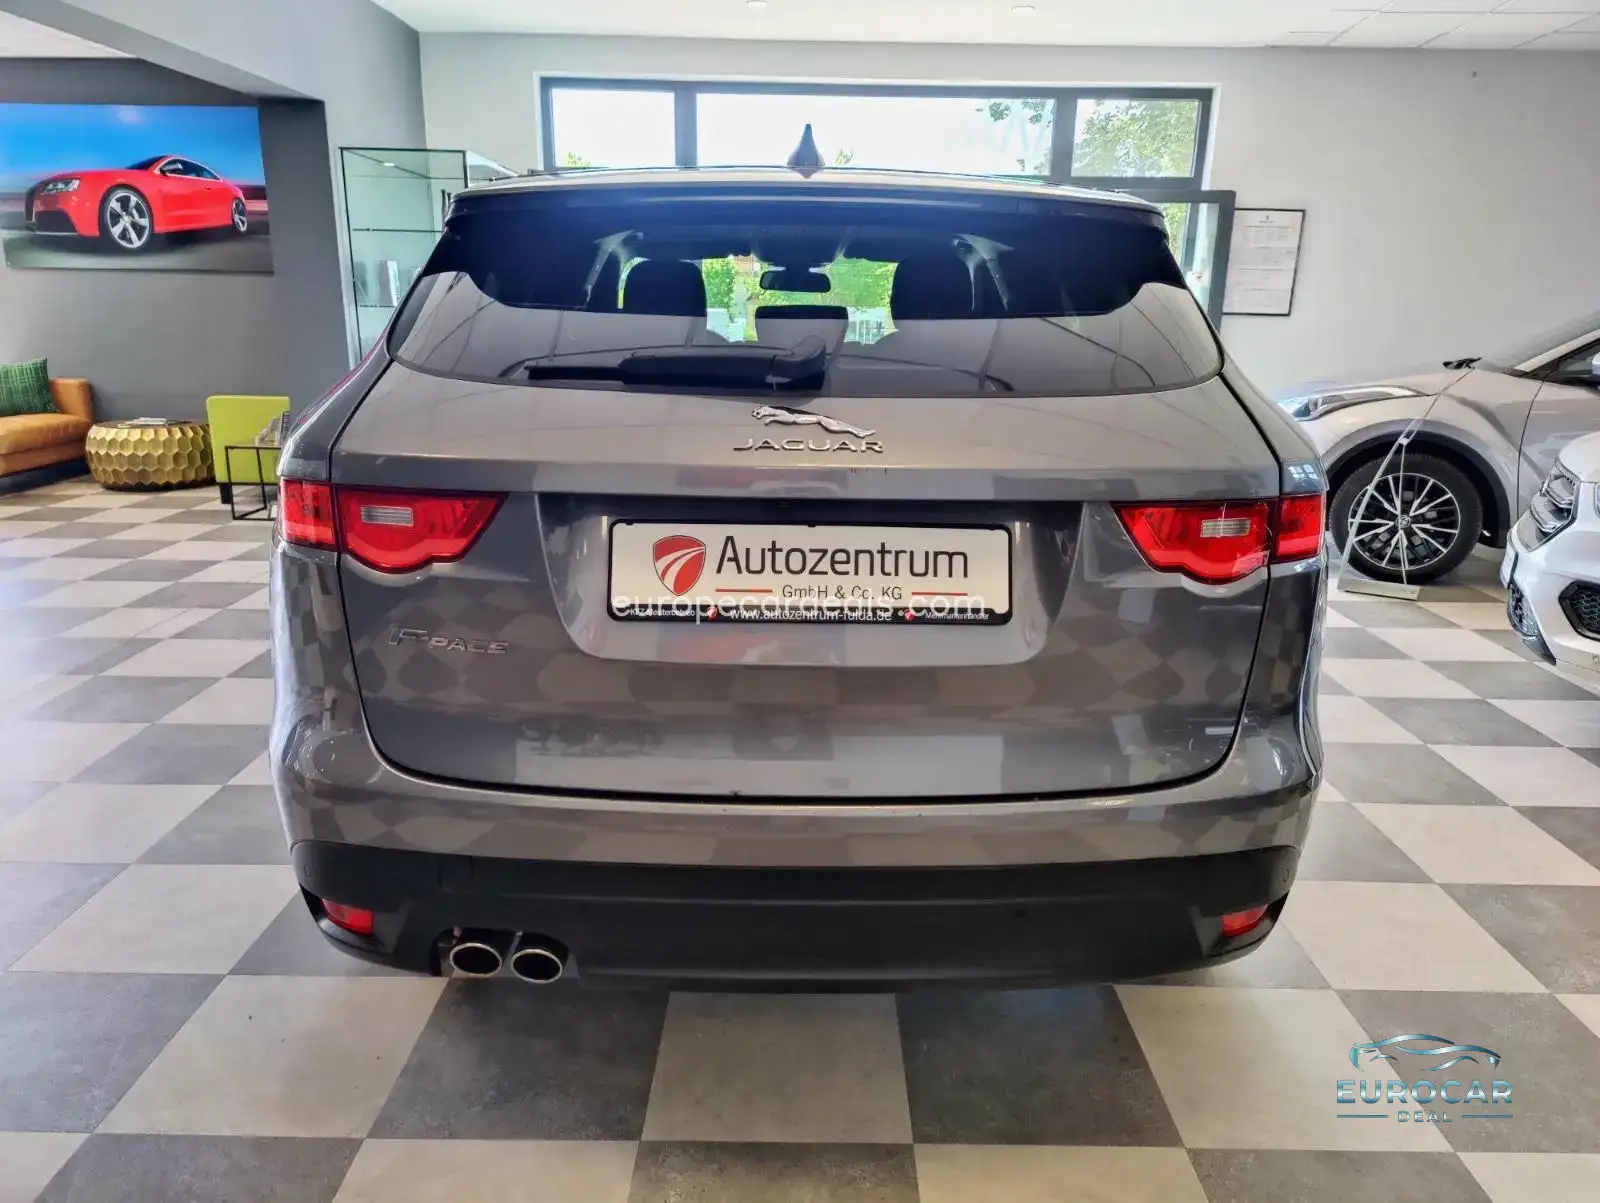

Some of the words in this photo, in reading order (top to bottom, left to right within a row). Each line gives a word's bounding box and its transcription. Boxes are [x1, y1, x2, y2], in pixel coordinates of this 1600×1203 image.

[733, 437, 884, 453] JAGUAR
[716, 535, 968, 578] Autozentrum
[782, 584, 829, 600] GmbH
[834, 585, 847, 599] &
[851, 586, 875, 600] Co.
[881, 586, 903, 600] KG
[730, 607, 893, 622] www.autozentrum-fulda.de
